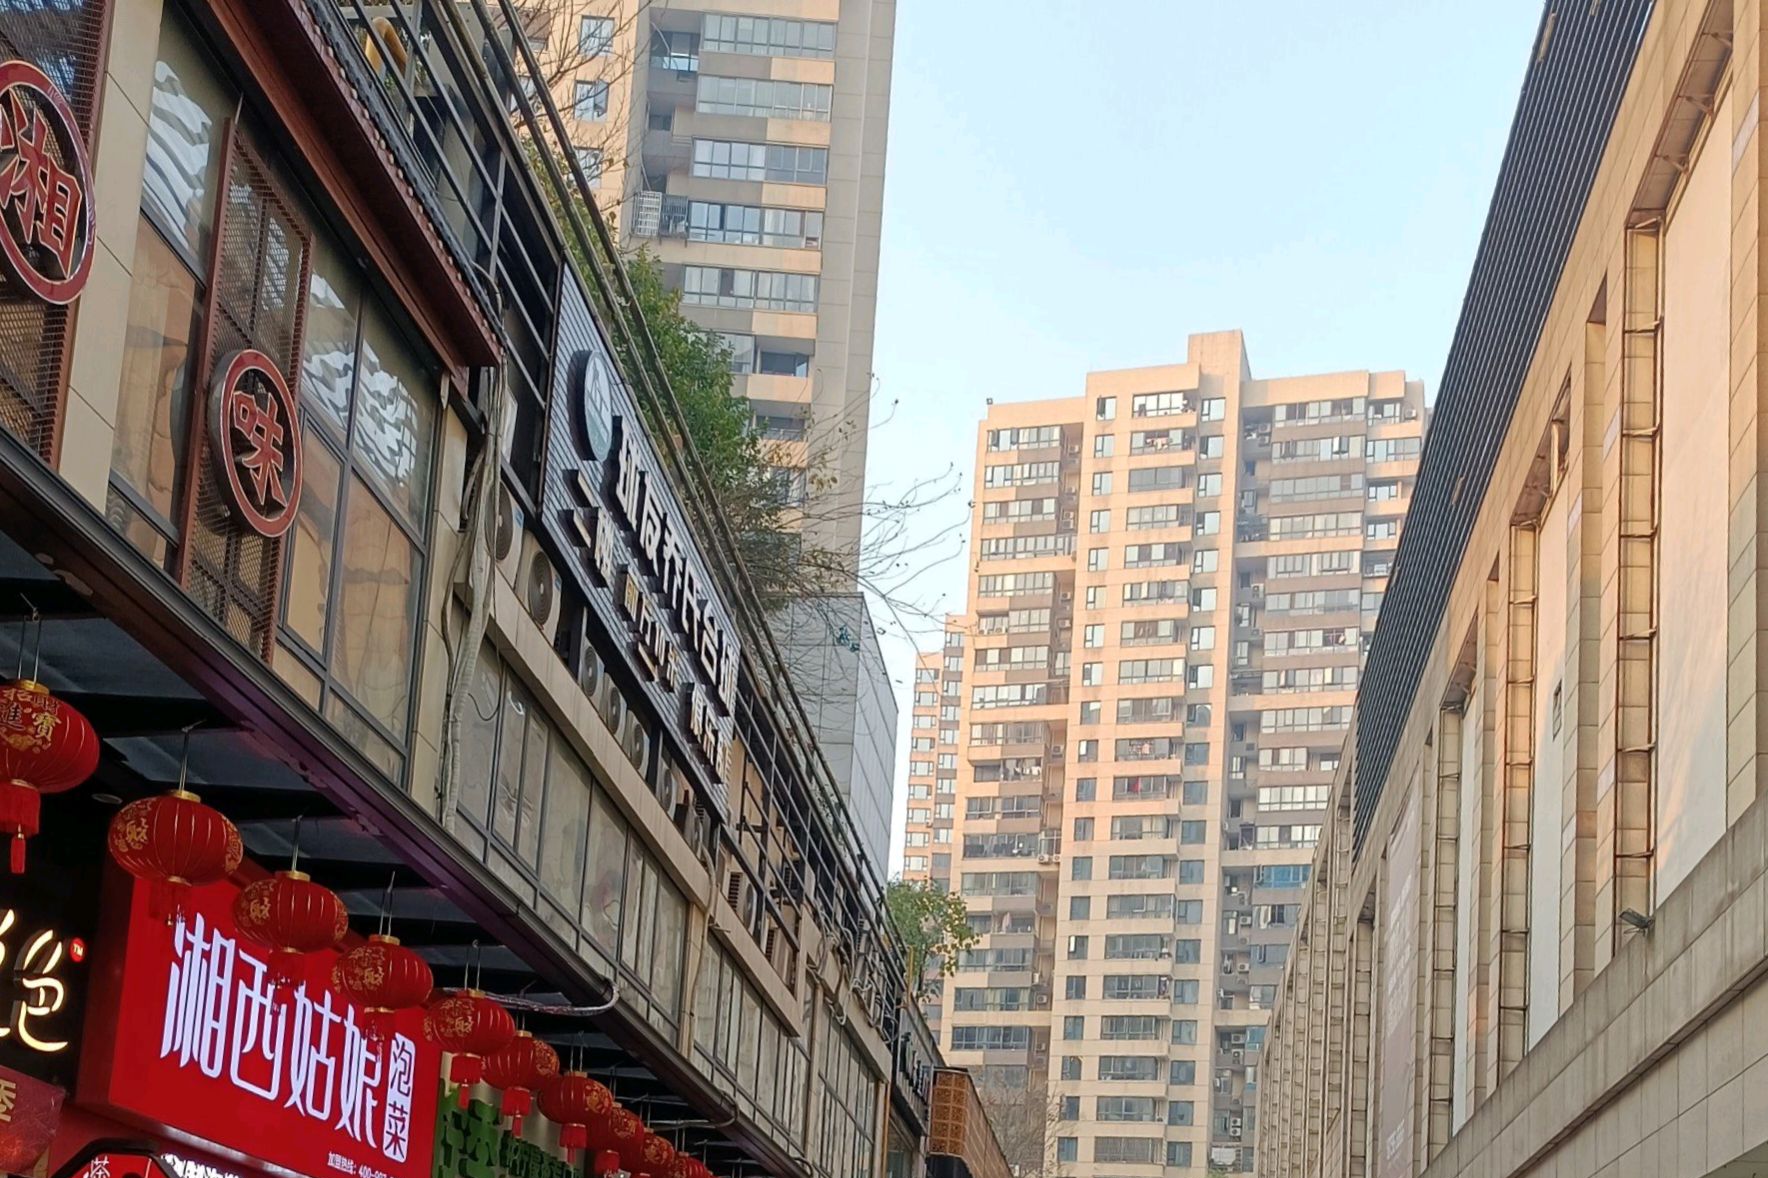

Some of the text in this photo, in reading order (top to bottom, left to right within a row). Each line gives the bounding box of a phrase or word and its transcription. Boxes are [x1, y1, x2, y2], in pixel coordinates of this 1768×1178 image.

[0, 90, 83, 280] 湘
[231, 388, 287, 507] 味
[160, 913, 384, 1150] 湘西姑娘
[386, 1040, 413, 1159] 泡菜
